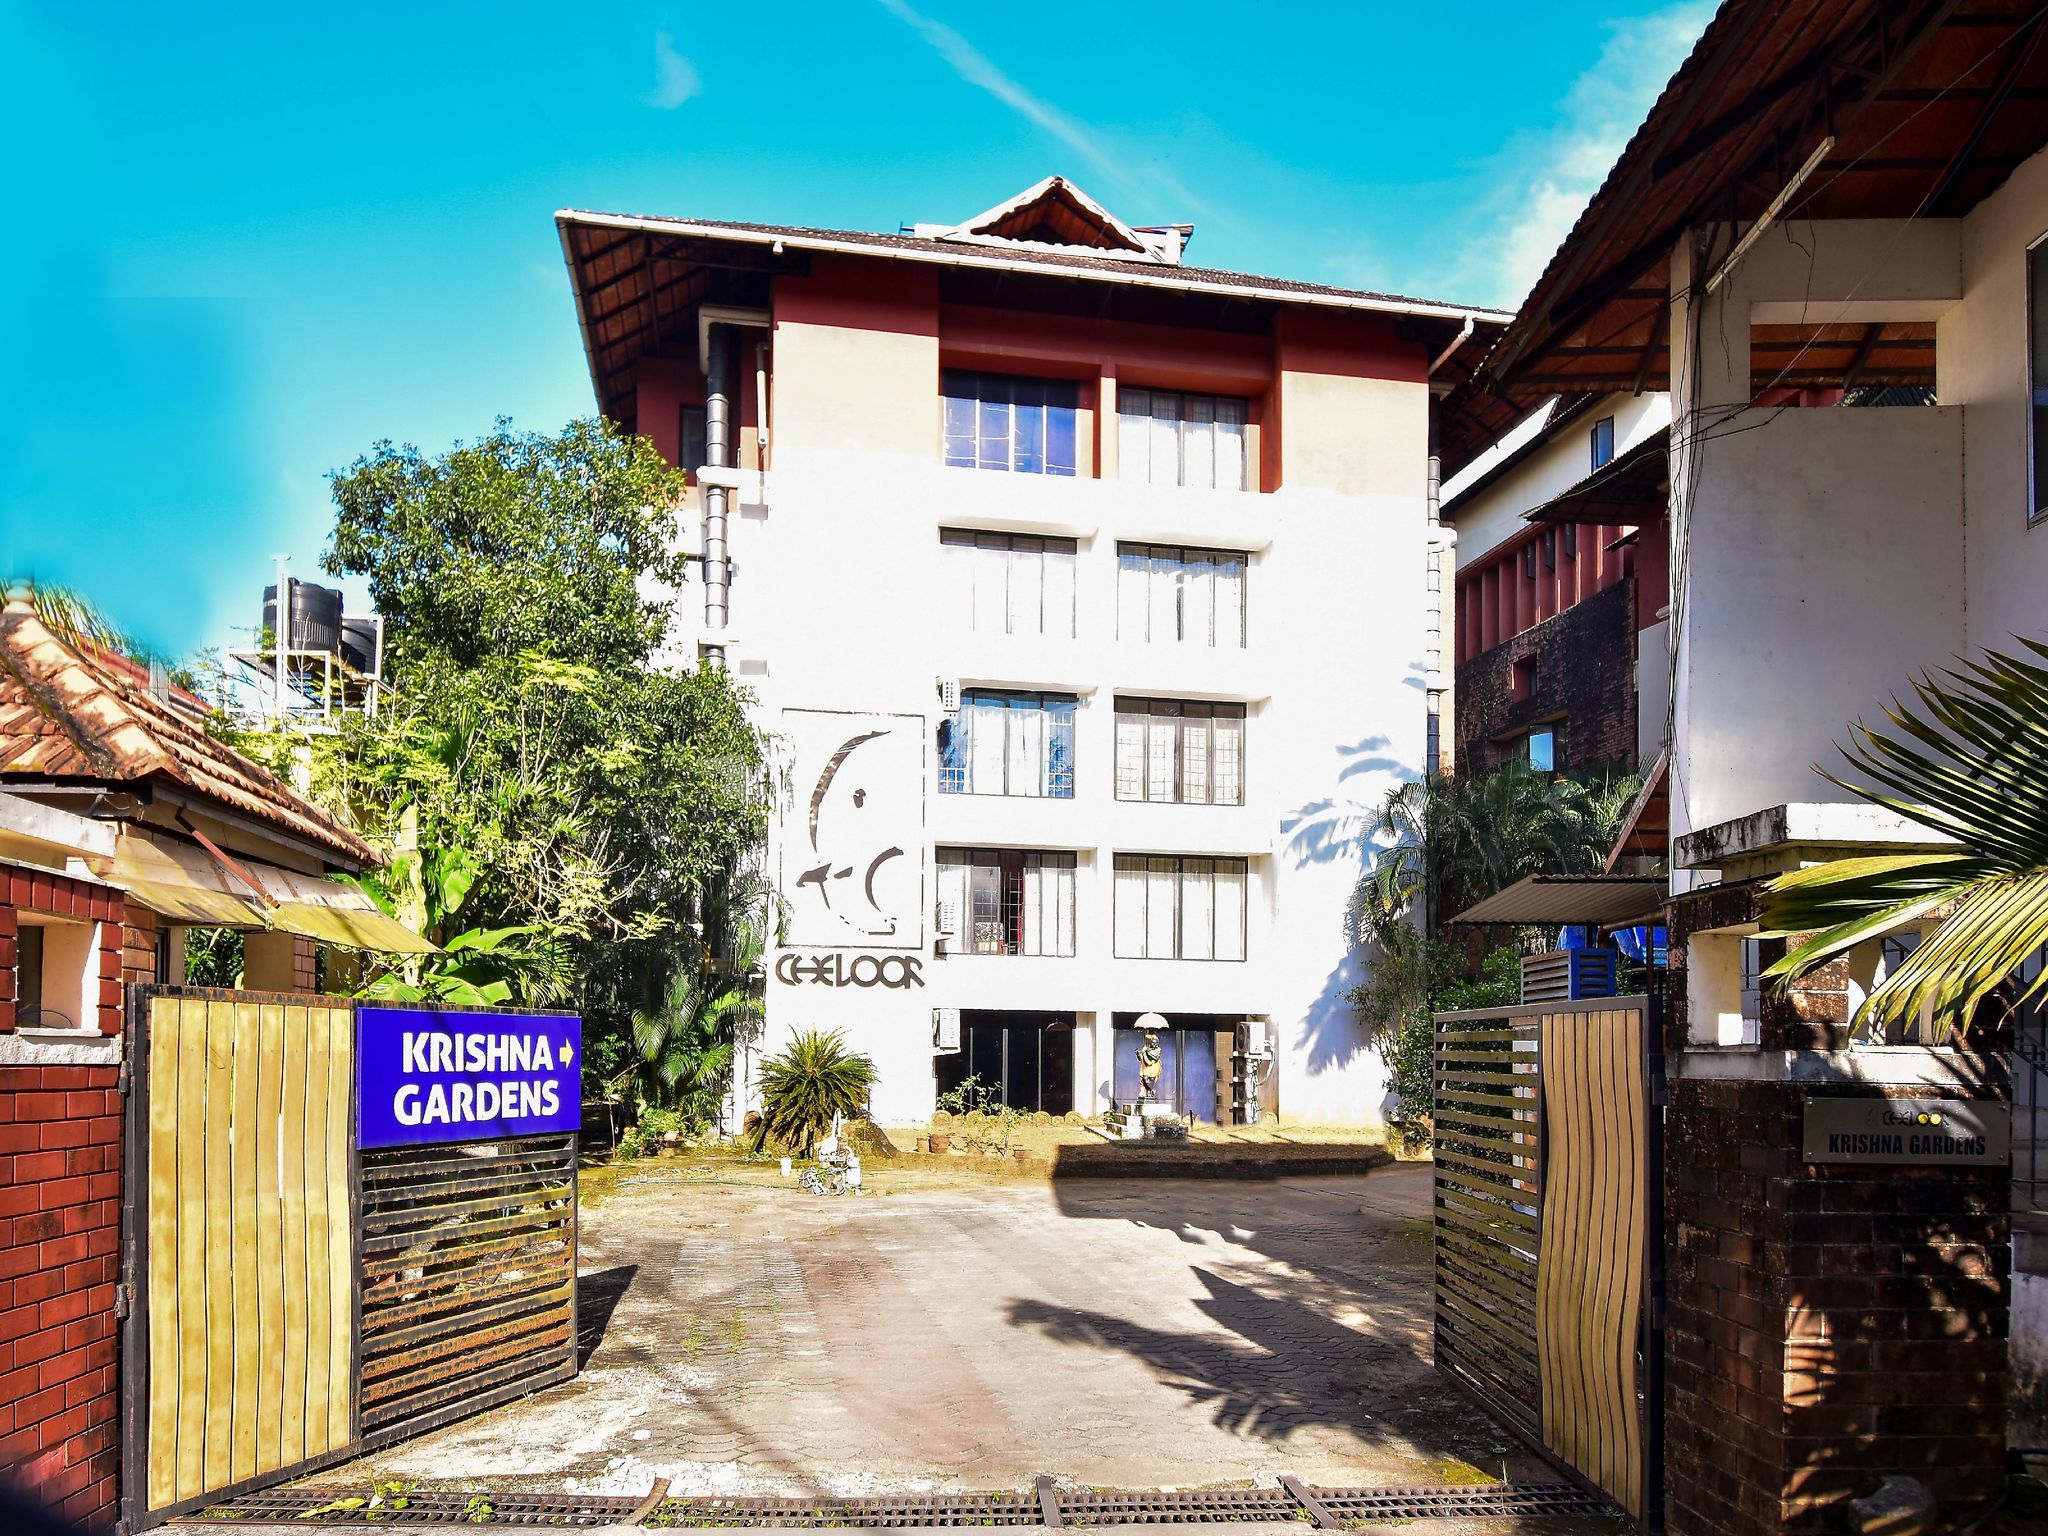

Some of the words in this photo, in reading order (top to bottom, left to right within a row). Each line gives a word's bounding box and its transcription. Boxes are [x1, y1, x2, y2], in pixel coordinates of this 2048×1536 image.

[403, 1032, 554, 1073] KRISHNA
[394, 1080, 560, 1126] GARDENS
[1828, 1133, 1903, 1153] KRISHNA
[1909, 1135, 1986, 1155] GARDENS
